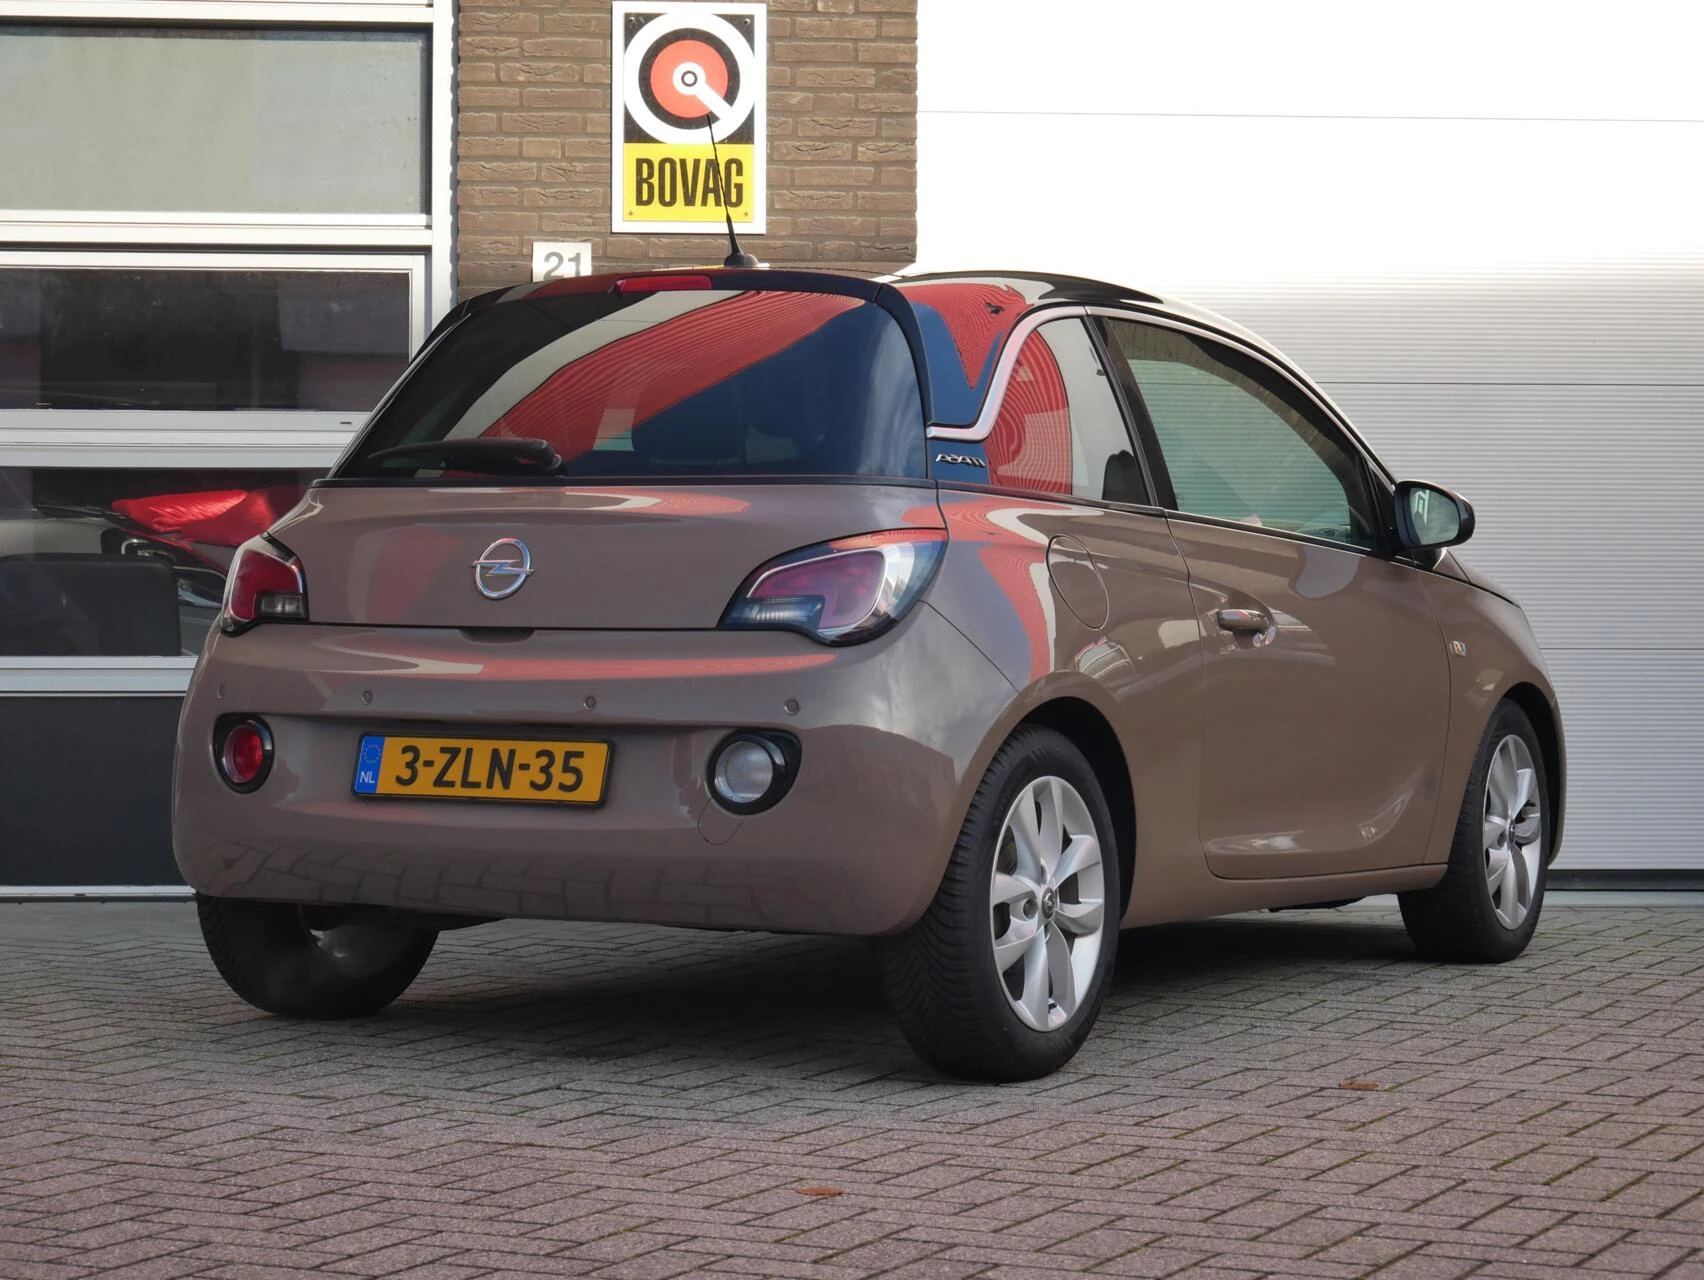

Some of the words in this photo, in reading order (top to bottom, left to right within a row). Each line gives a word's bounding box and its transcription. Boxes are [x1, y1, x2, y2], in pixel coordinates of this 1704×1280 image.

[635, 156, 743, 208] BOVAG
[543, 251, 581, 281] 21
[359, 770, 375, 784] NL
[395, 745, 585, 793] 3-ZLN-35
